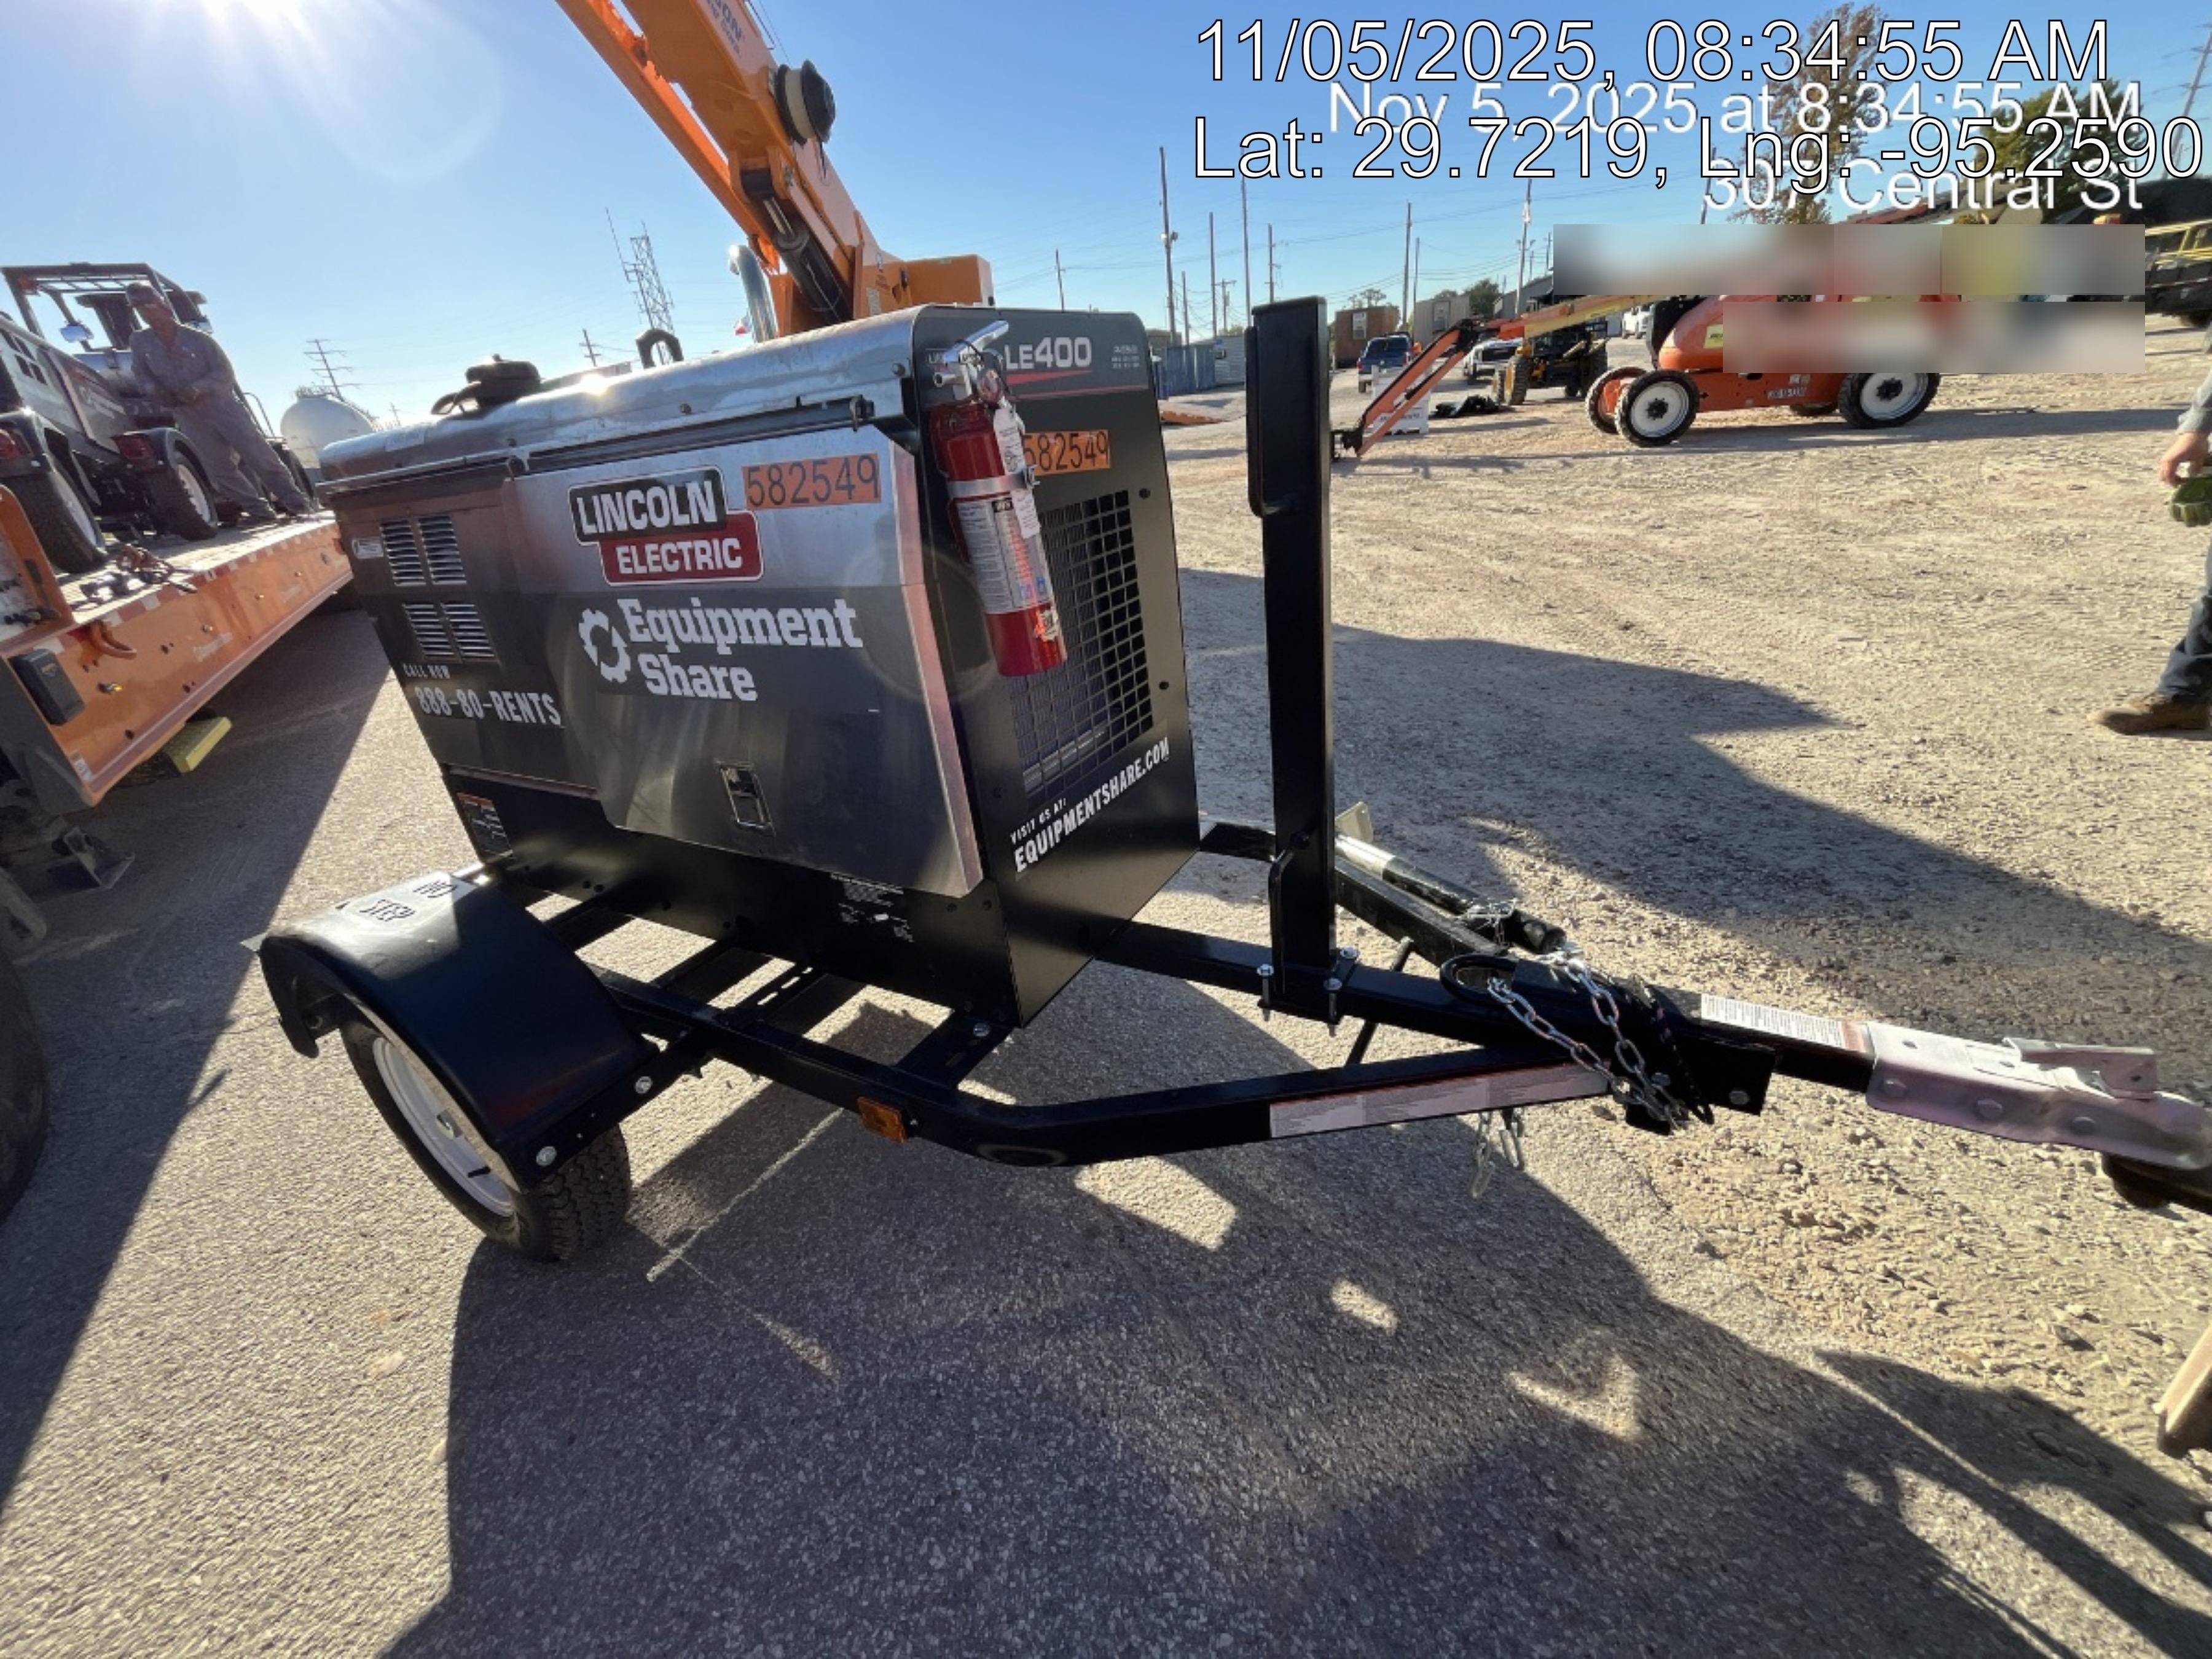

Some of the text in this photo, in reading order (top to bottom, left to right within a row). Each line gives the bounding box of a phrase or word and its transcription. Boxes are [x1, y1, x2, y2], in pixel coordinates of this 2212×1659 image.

[1003, 336, 1092, 371] LE400
[747, 454, 880, 508] 582549
[576, 480, 718, 535] LINCOLN
[616, 538, 742, 575] ELECTRIC
[618, 597, 863, 655] Equipment
[403, 663, 428, 677] CALL
[637, 653, 758, 702] Share
[414, 685, 561, 726] 888-80-RENTS
[1010, 818, 1035, 845] VISIT
[1039, 808, 1051, 825] US
[1014, 736, 1170, 873] EQUIPMENTSHARE.COM
